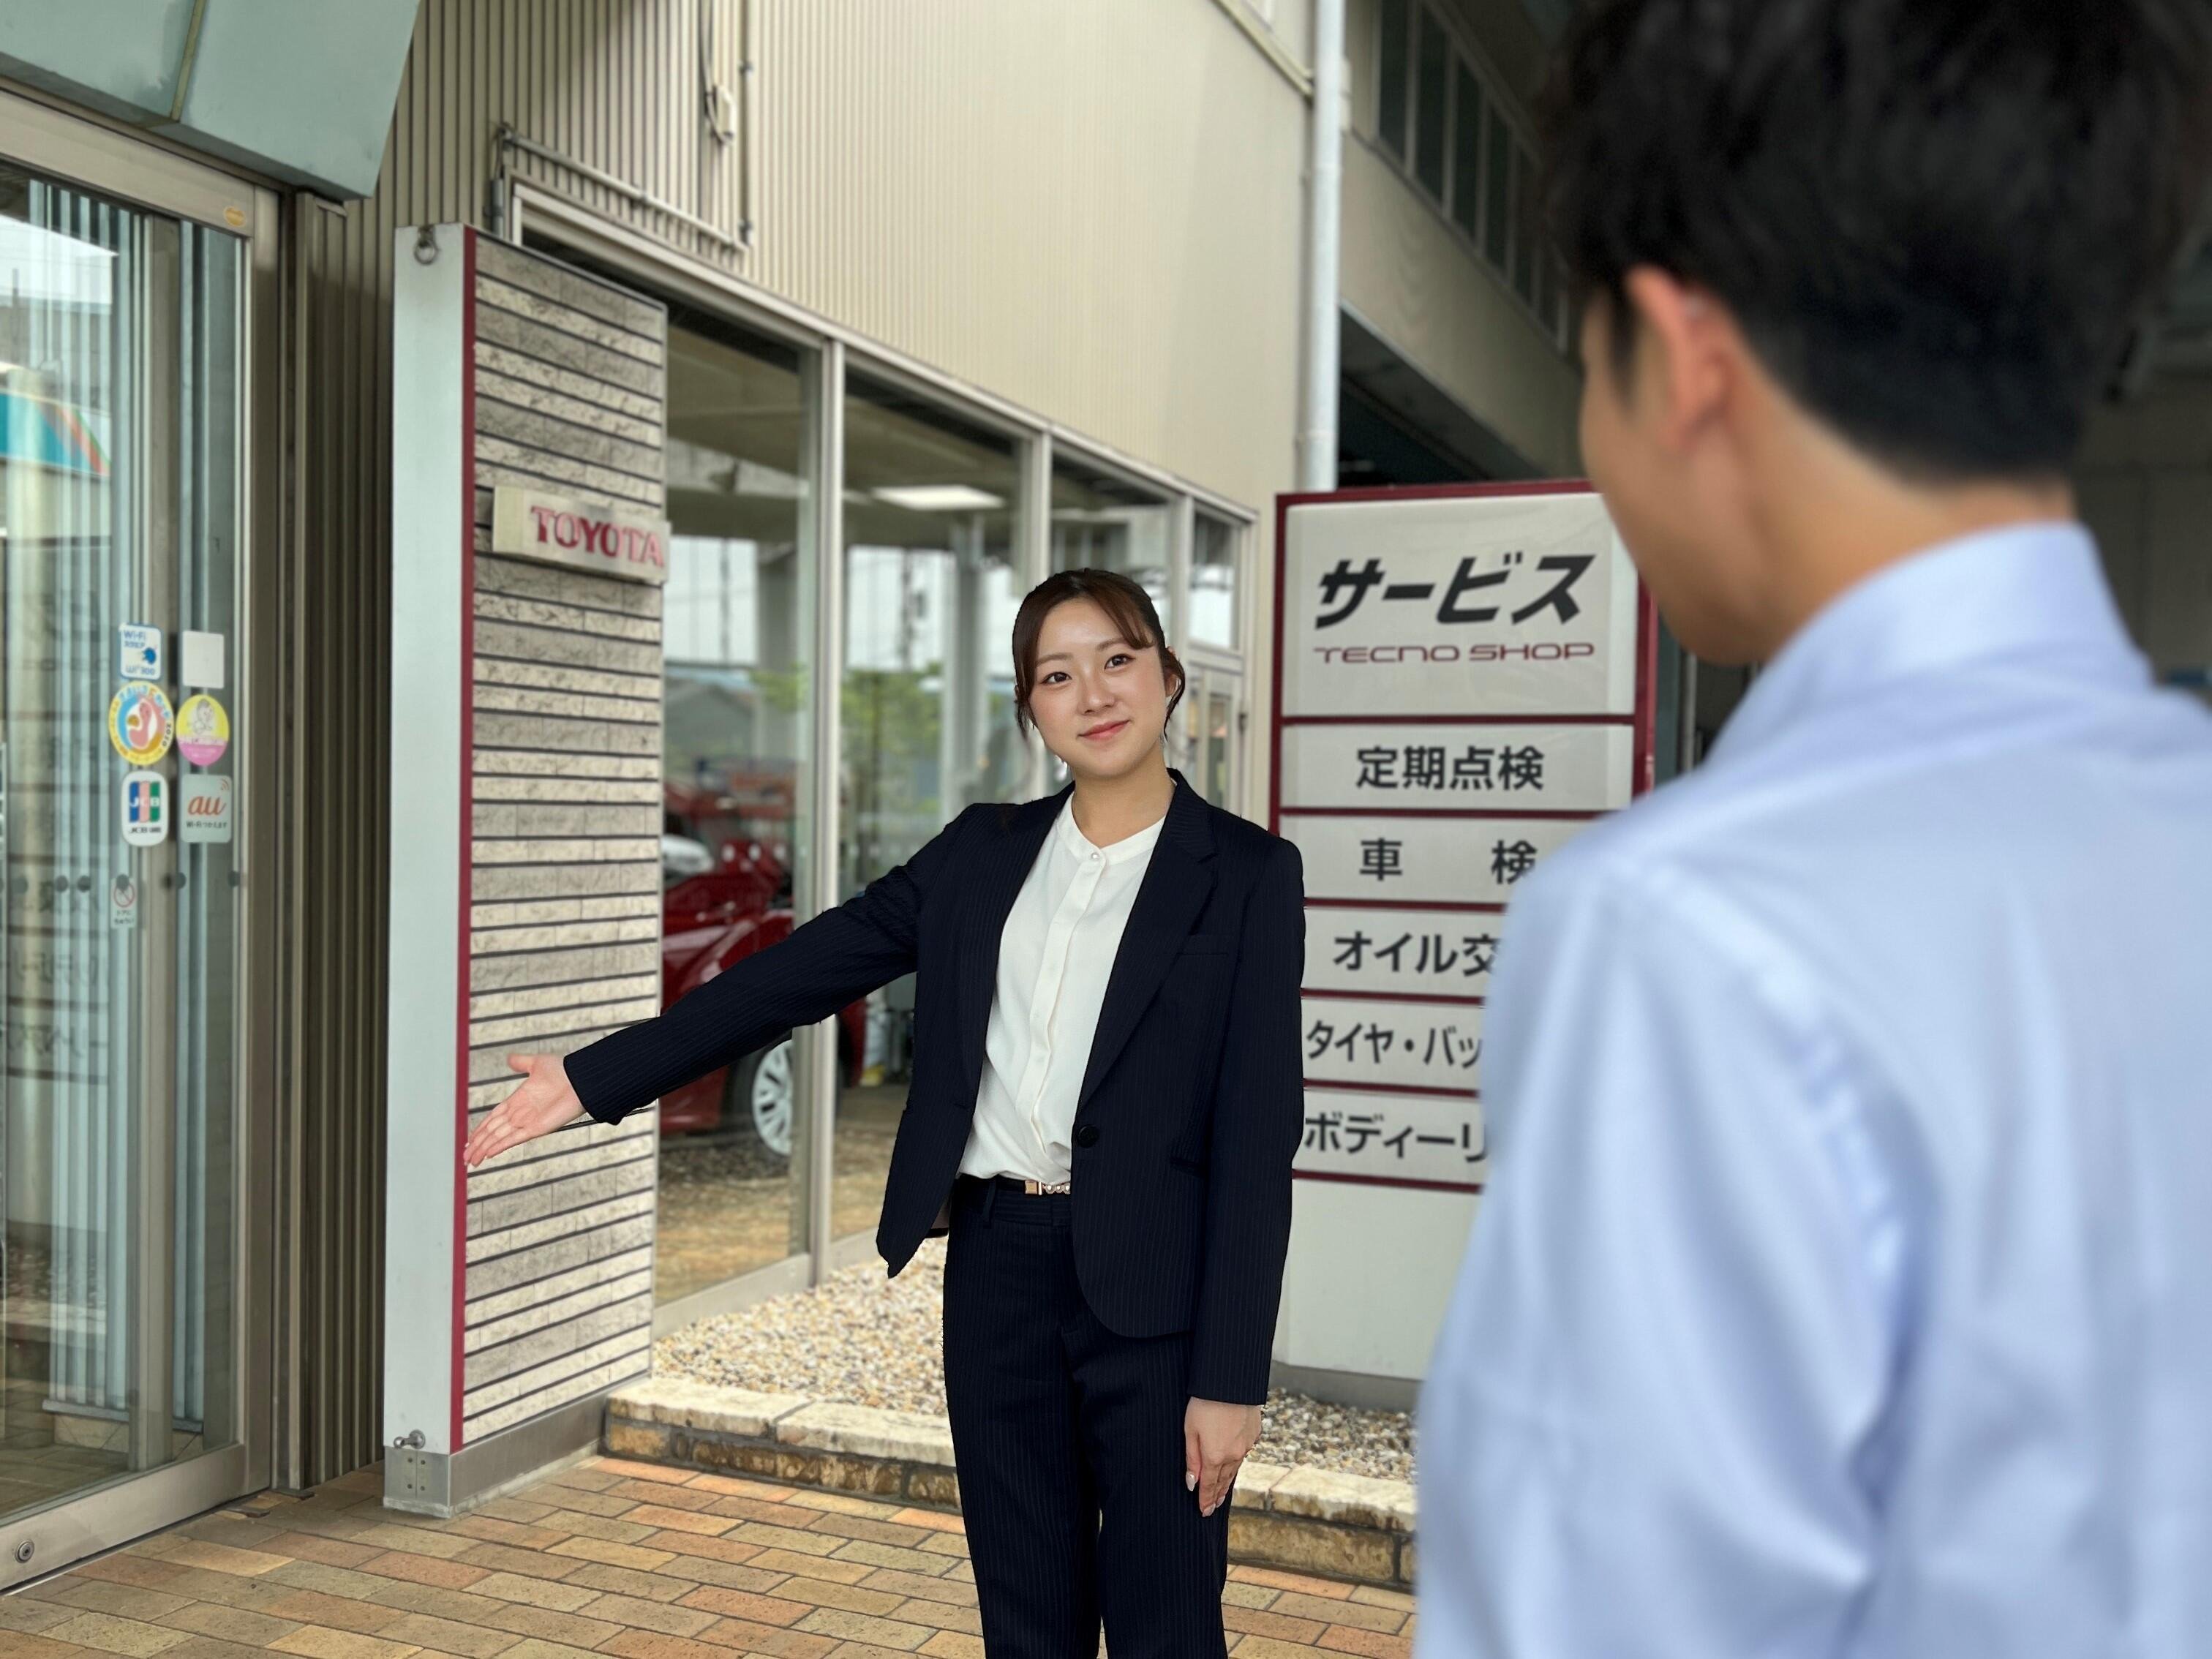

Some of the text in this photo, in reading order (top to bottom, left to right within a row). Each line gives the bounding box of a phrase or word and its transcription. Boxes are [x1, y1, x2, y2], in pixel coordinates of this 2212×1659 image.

[530, 505, 666, 568] TOYOTA
[1314, 550, 1597, 631] サービス
[1314, 642, 1595, 663] TECNO SHOP
[1355, 745, 1545, 791] 定期点検
[187, 795, 227, 816] au
[1333, 930, 1500, 977] オイル交
